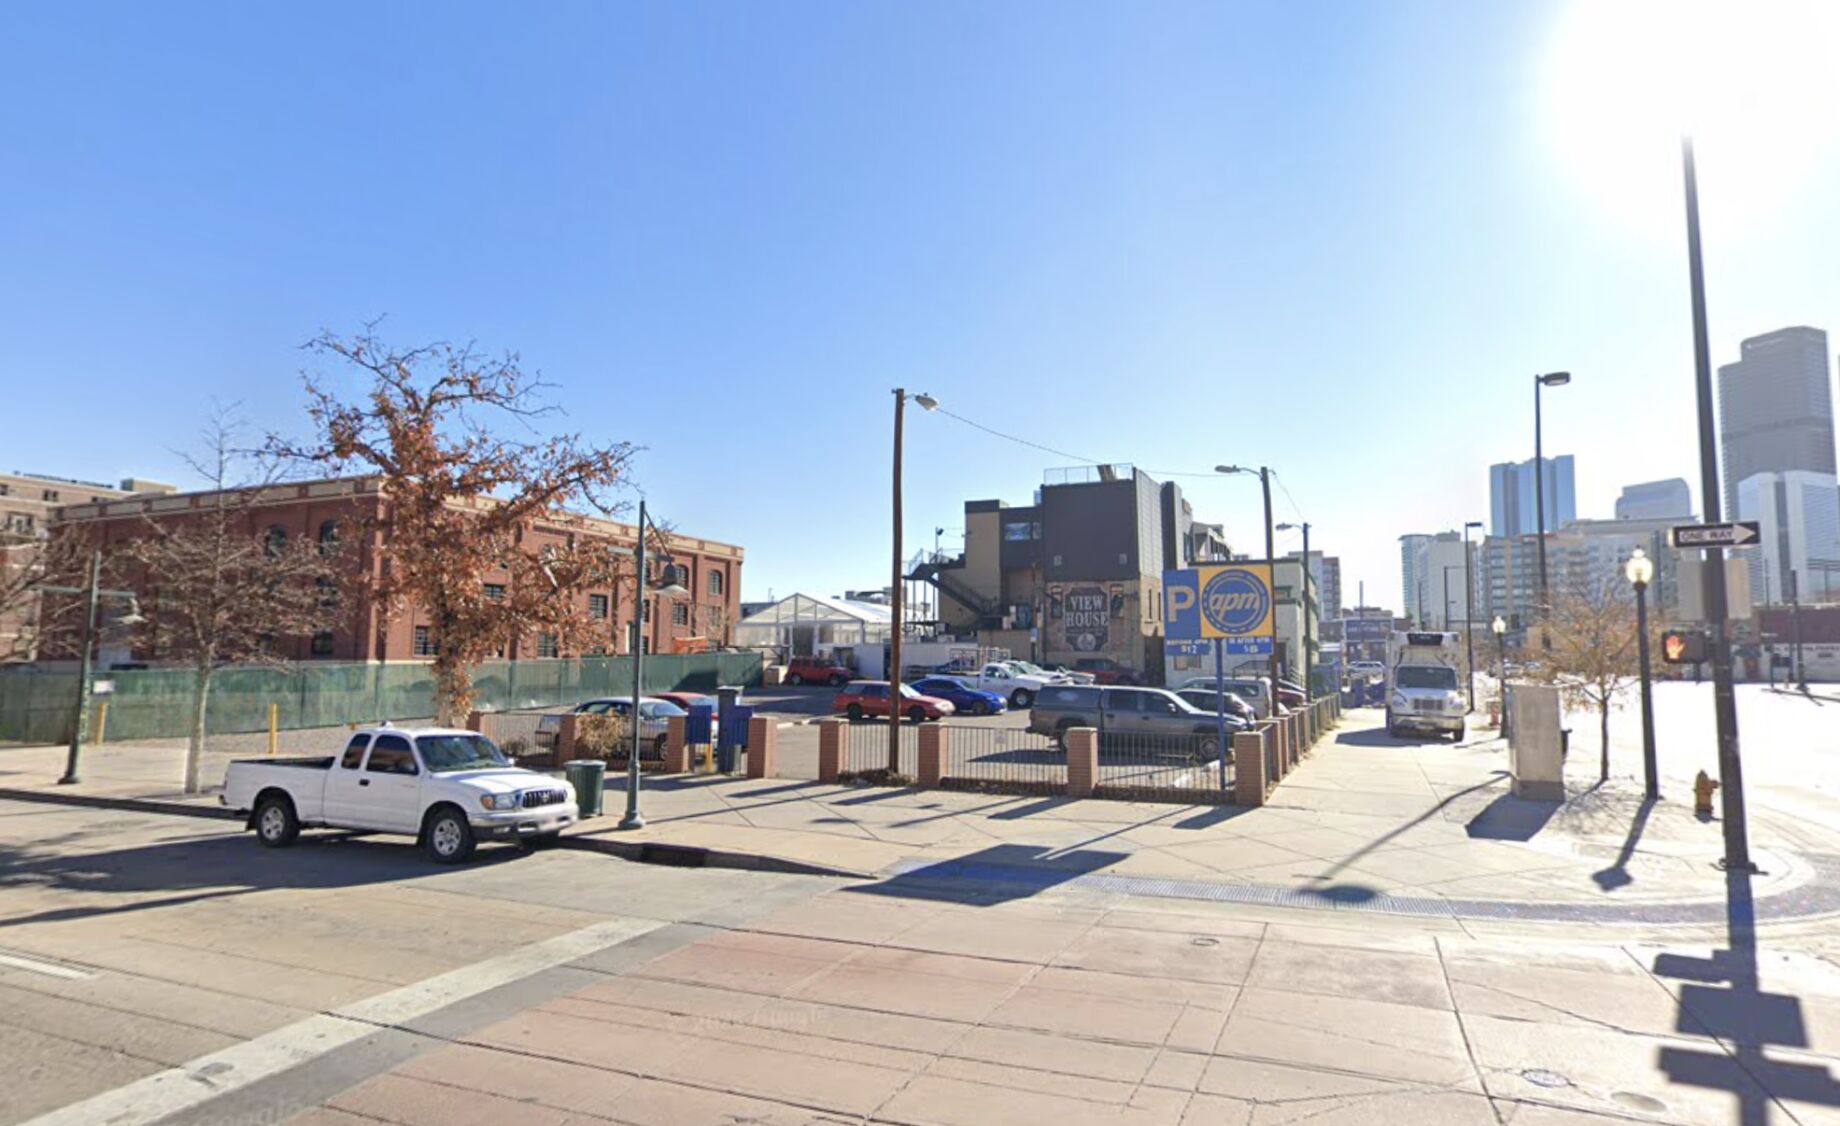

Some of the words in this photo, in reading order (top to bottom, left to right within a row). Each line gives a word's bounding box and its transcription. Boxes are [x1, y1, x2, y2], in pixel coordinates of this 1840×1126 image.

[1681, 530, 1703, 542] ONE
[1709, 529, 1733, 540] WAY
[1070, 596, 1103, 610] VIEW
[1167, 585, 1195, 623] P
[1211, 592, 1259, 621] apm
[1066, 611, 1108, 627] HOUSE
